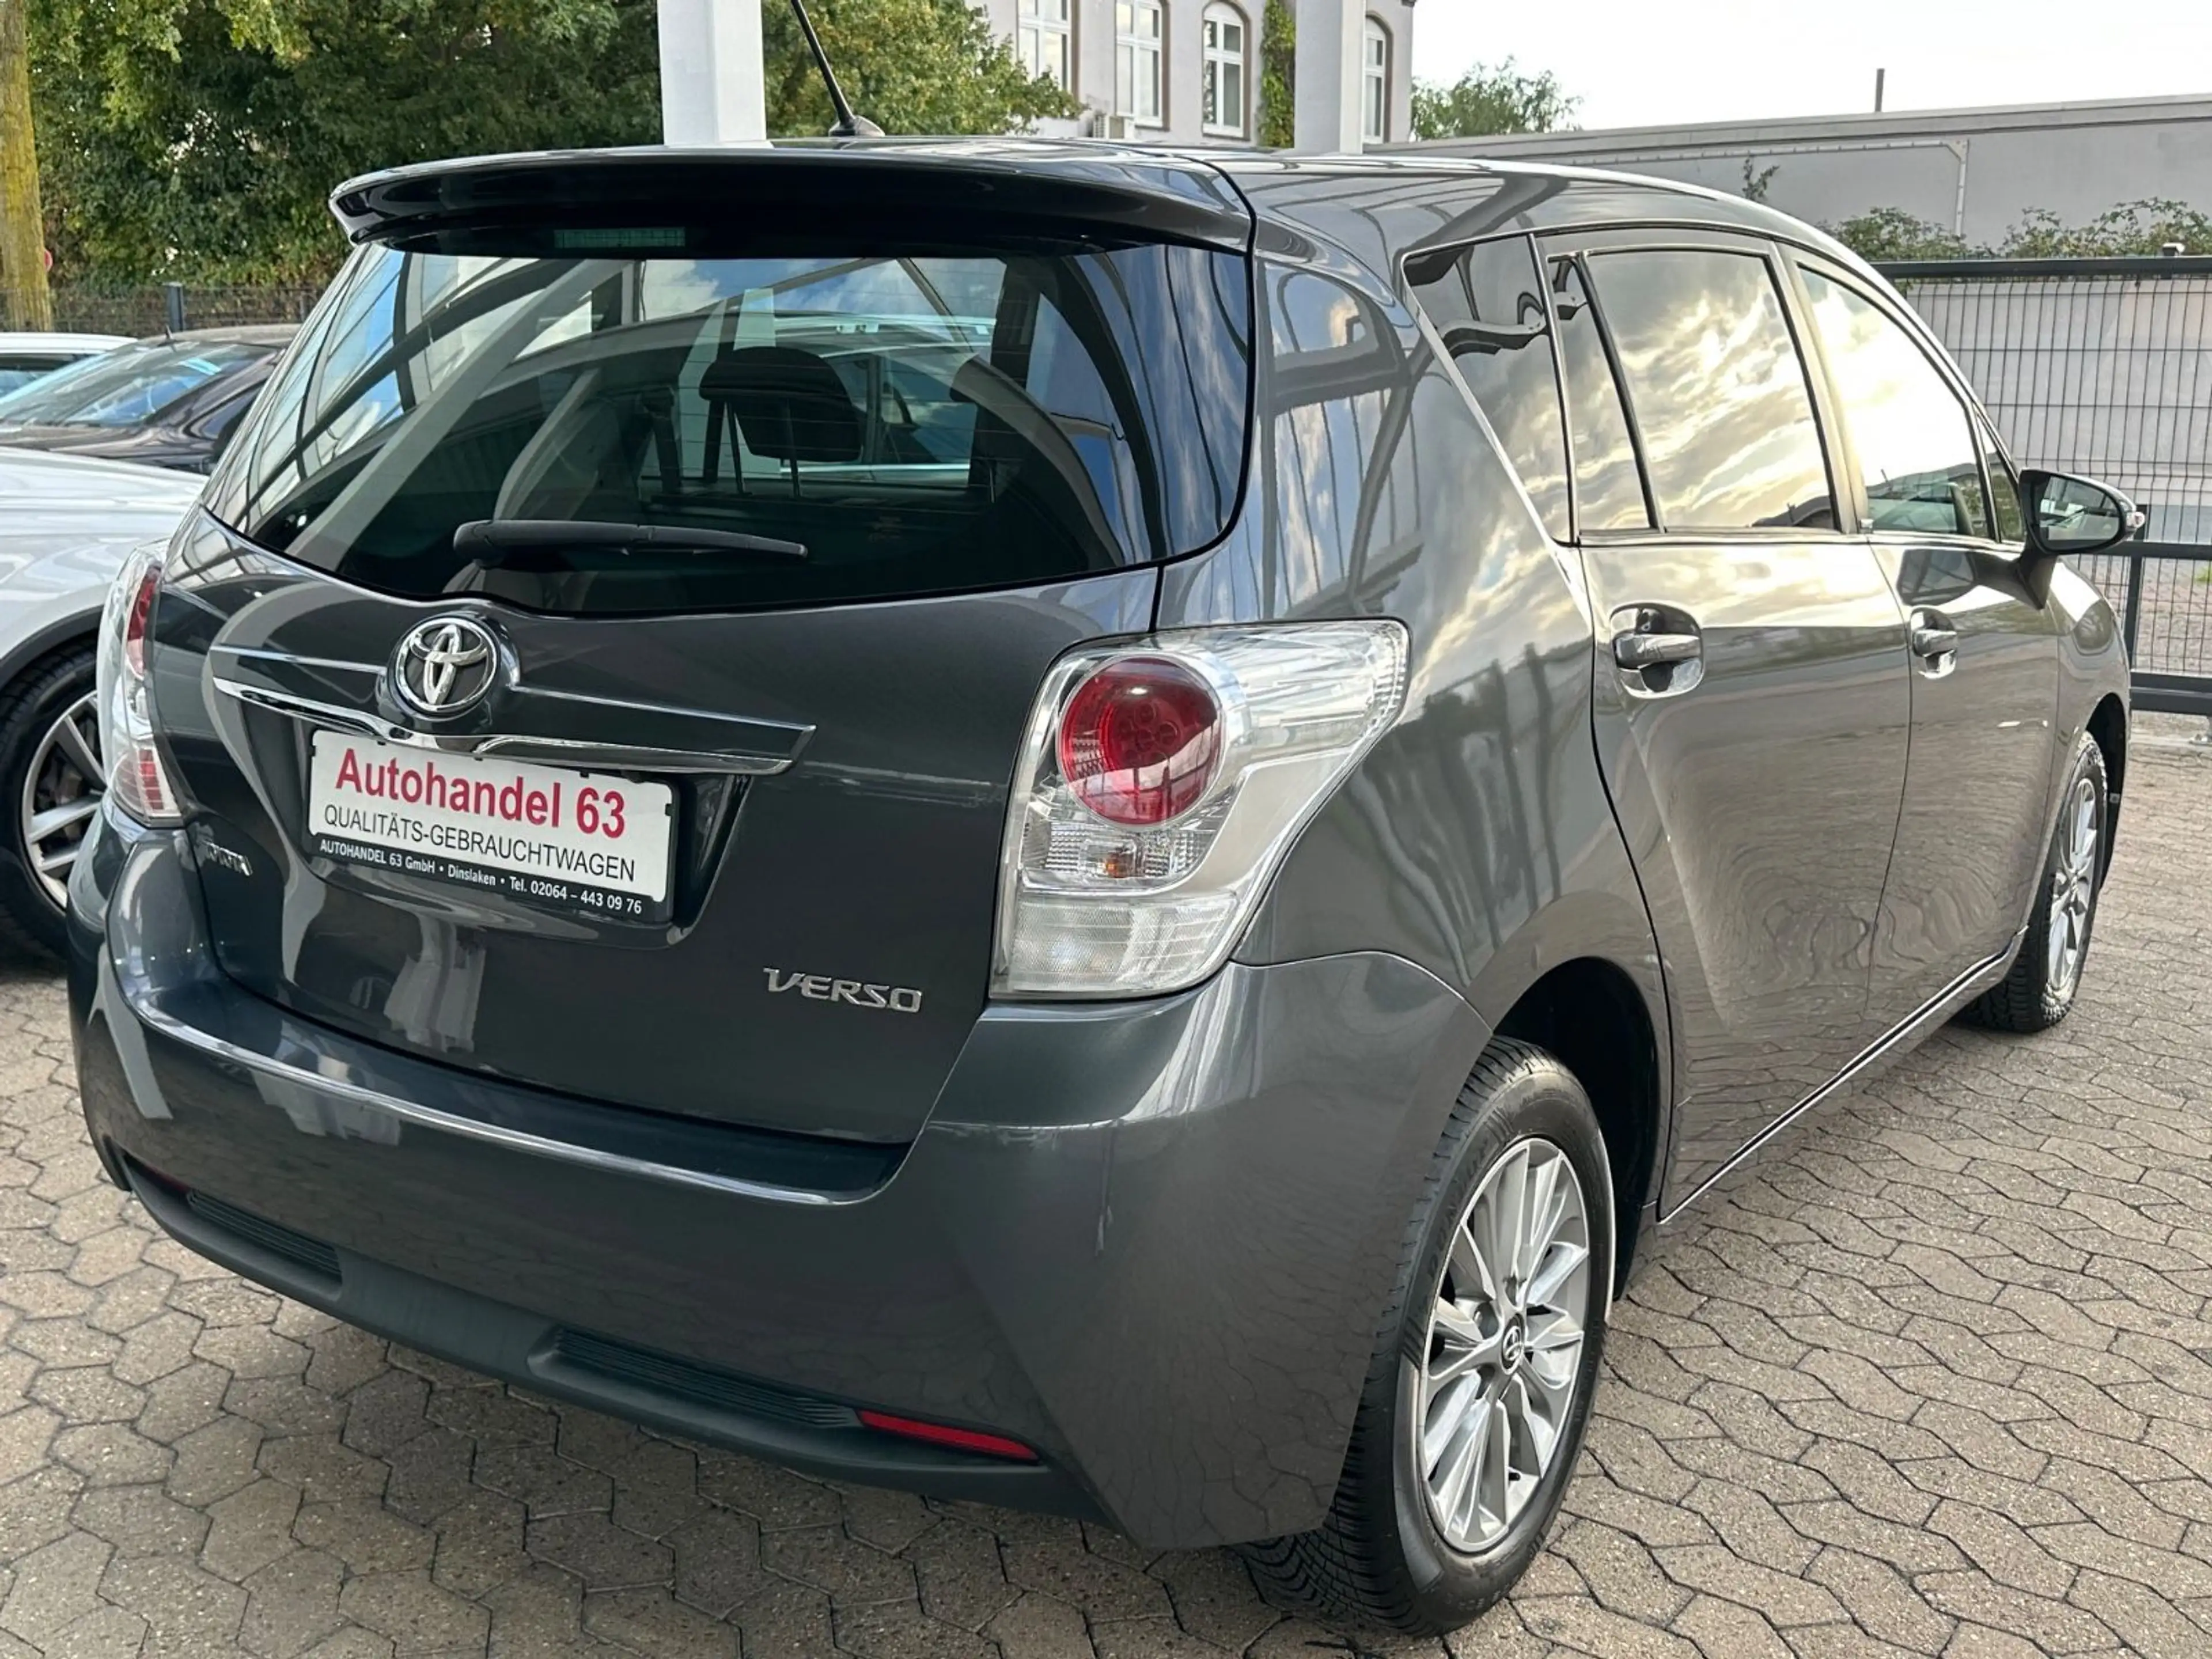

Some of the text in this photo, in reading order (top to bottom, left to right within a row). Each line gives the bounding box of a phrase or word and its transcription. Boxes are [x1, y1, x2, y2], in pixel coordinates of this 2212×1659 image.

[335, 748, 626, 839] Autohandel 63
[320, 839, 387, 864] AUTOHANDEL
[389, 853, 403, 867] 63
[405, 856, 435, 873] GmbH
[448, 863, 496, 886] Dinslaken
[509, 876, 528, 892] Tel.
[531, 880, 567, 900] 02064
[580, 890, 604, 907] 443
[607, 895, 623, 910] 09
[626, 898, 642, 914] 76
[324, 804, 635, 882] QUALITÄTS-GEBRAUCHTWAGEN
[763, 967, 922, 1013] VERSO
